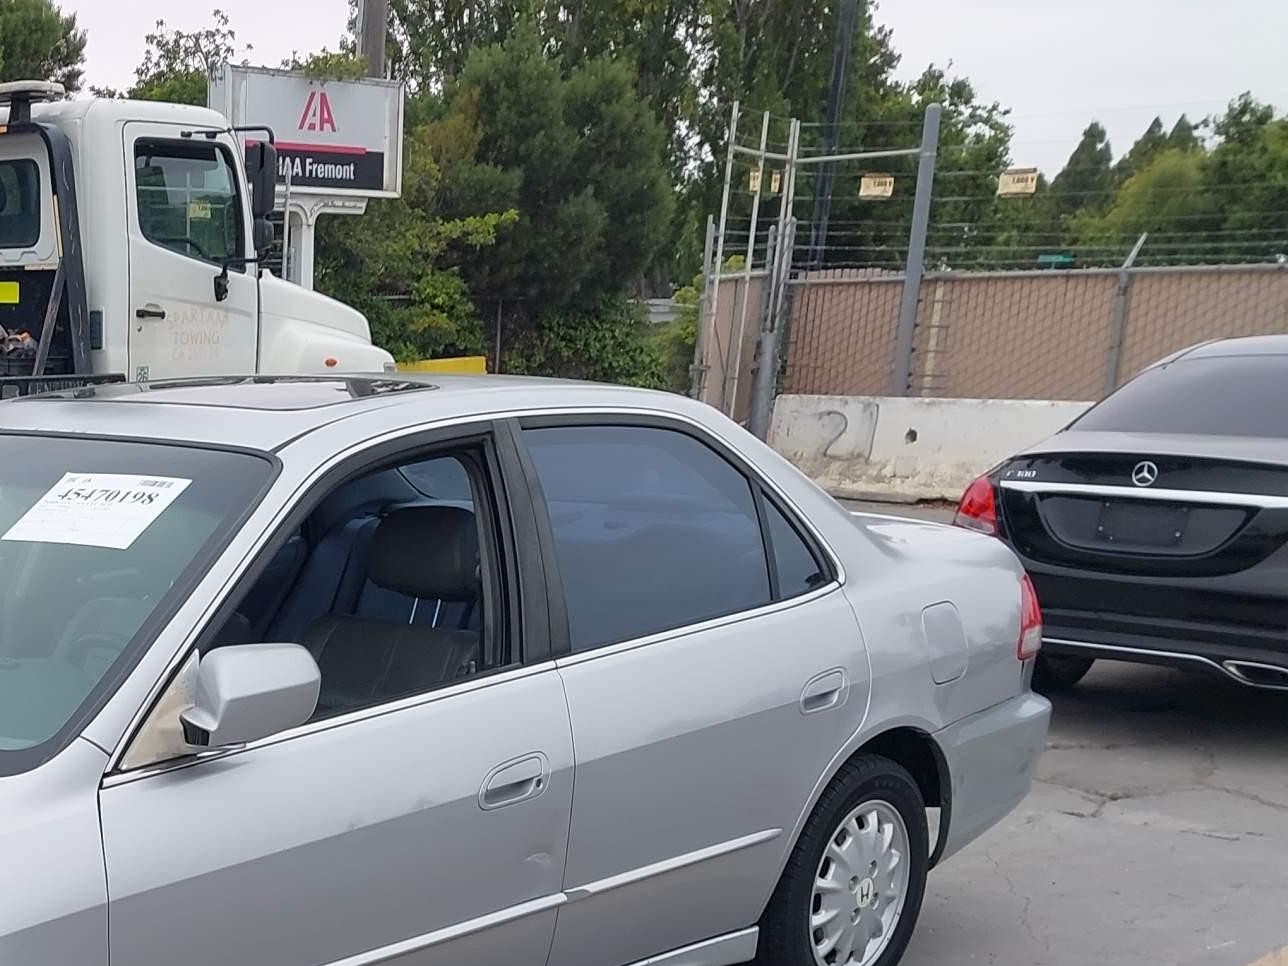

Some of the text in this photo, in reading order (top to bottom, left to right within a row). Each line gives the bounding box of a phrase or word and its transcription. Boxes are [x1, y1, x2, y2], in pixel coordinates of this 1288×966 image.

[278, 156, 355, 180] IAA Fremont
[174, 331, 220, 345] TOWING
[57, 487, 160, 505] 45470198
